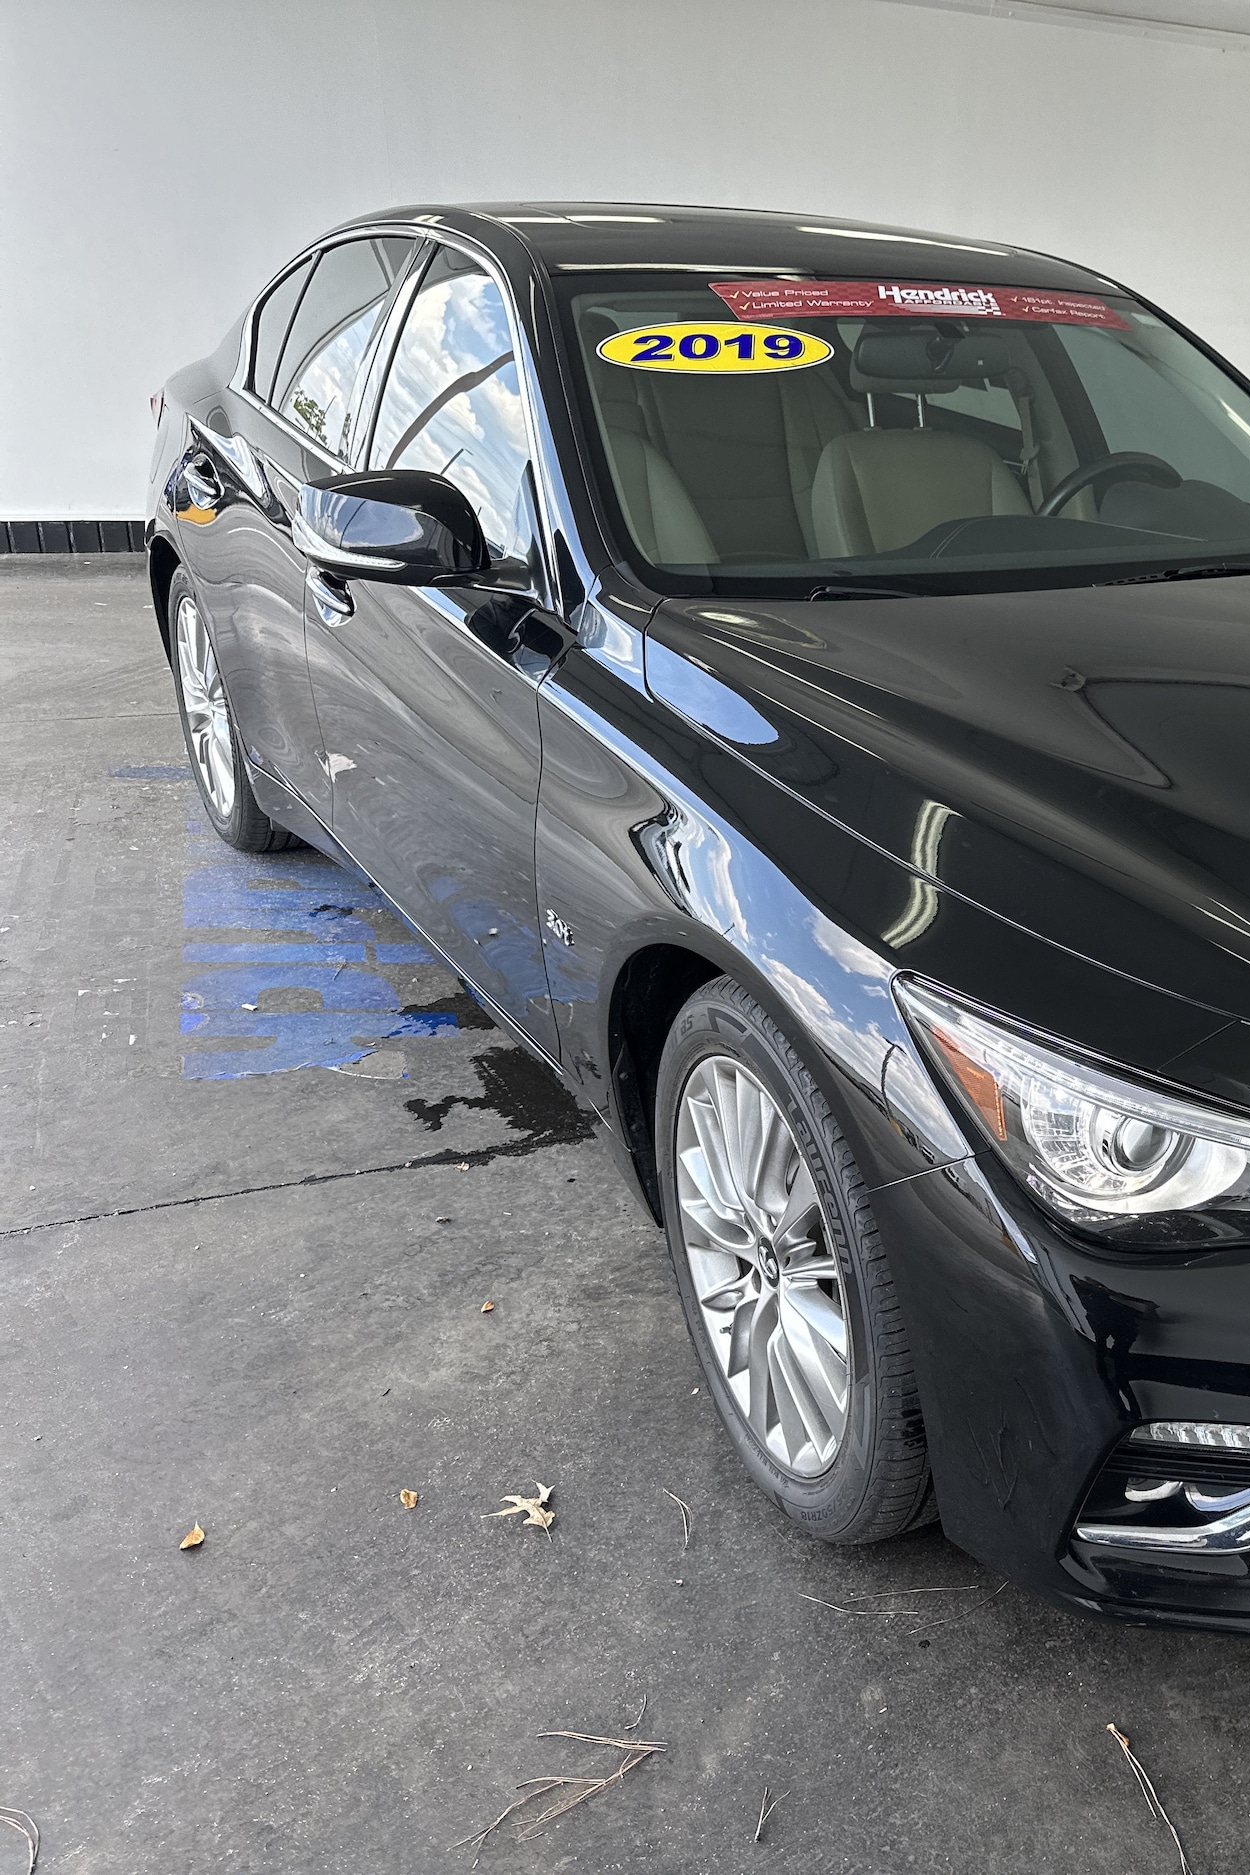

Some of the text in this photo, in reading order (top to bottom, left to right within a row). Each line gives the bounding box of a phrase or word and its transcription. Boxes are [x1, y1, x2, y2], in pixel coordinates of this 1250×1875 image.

[742, 289, 829, 298] Value Priced
[878, 285, 996, 304] Hendrick
[752, 300, 803, 309] Limited
[1031, 307, 1107, 320] Carfax Report
[632, 333, 804, 361] 2019
